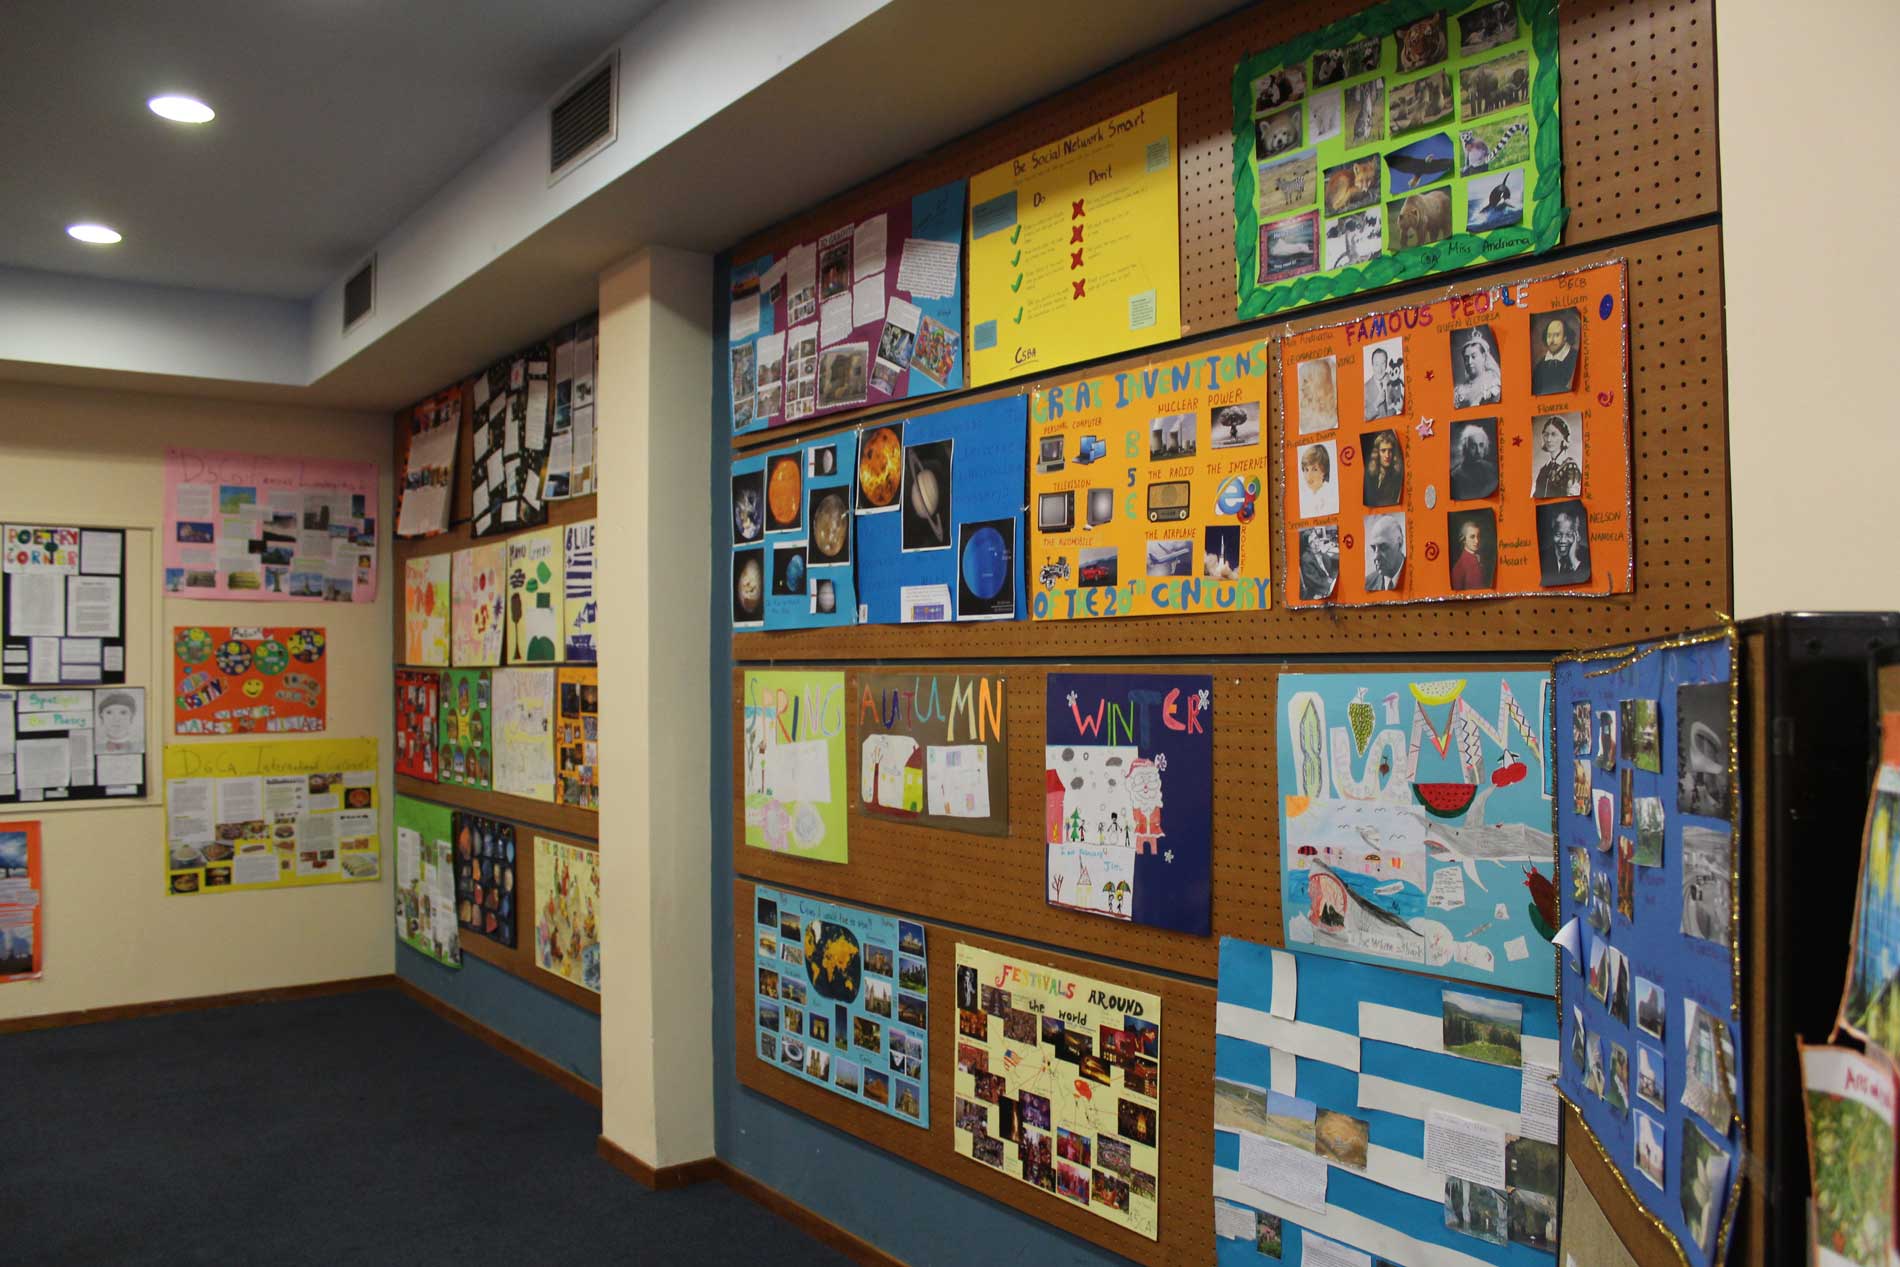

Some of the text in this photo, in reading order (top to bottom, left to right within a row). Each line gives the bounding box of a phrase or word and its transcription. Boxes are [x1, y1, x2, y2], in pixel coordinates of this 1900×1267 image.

[1013, 159, 1027, 177] Be
[1031, 143, 1061, 170] Social
[1063, 128, 1104, 156] Network
[1108, 111, 1145, 138] Smart
[1345, 283, 1529, 346] FAMOUS PEOPLE
[1032, 341, 1268, 424] GREAT INVENTIONS
[1158, 389, 1243, 414] NUCLEAR POWER
[1072, 416, 1103, 431] COMPUTER
[1148, 465, 1195, 480] THE RADIO
[1206, 455, 1268, 475] THE INTERNET
[1053, 479, 1092, 492] TELEVISION
[1589, 511, 1621, 524] NELSON
[566, 525, 595, 551] BLUE
[1145, 527, 1197, 541] THE AIRPLANE
[6, 548, 78, 567] CORNER
[1034, 588, 1061, 620] OF
[1064, 584, 1098, 618] THE
[1151, 577, 1270, 611] CENTURY
[744, 677, 844, 745] SPRING
[859, 674, 1003, 744] AUTUMN
[1071, 687, 1205, 748] WINTER
[995, 964, 1145, 1017] FESTIVALS AROUND
[1029, 999, 1089, 1026] the world
